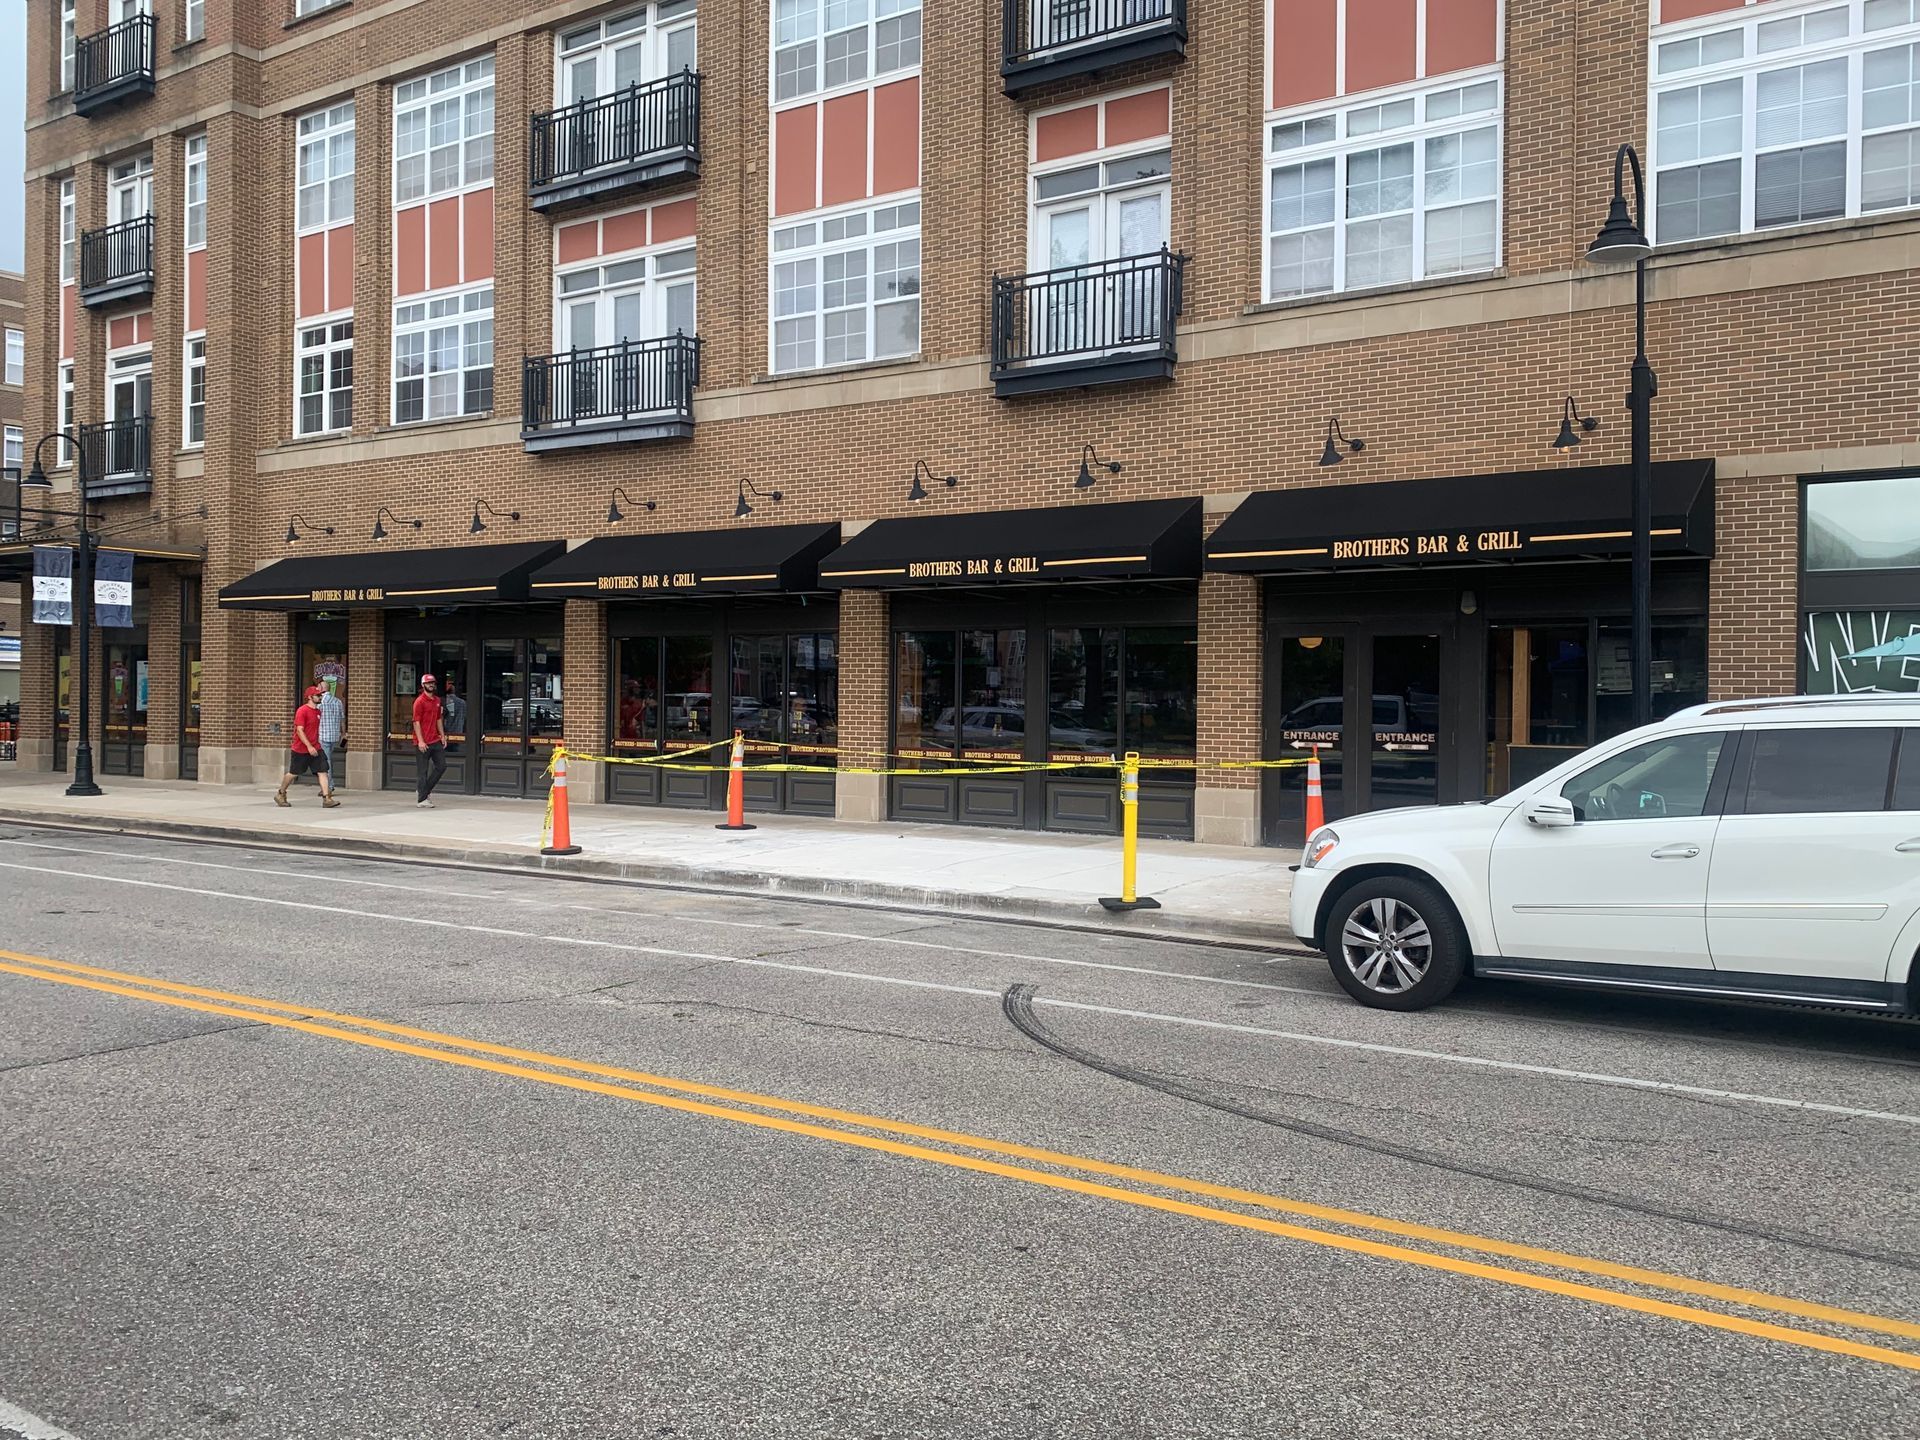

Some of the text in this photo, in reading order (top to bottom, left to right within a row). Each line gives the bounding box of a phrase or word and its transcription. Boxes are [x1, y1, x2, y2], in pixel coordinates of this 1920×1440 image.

[1332, 531, 1523, 559] BROTHERS BAR & GRILL
[909, 557, 1040, 578] BROTHERS BAR & GRILL
[598, 573, 697, 590] BROTHERS BAR & GRILL
[311, 588, 384, 602] BROTHERS BAR & GRILL
[1283, 731, 1340, 741] ENTRANCE
[1375, 732, 1436, 743] ENTRANCE
[964, 751, 1021, 760] BROTHERS BROTHERS
[1052, 754, 1082, 762] BROTHERS
